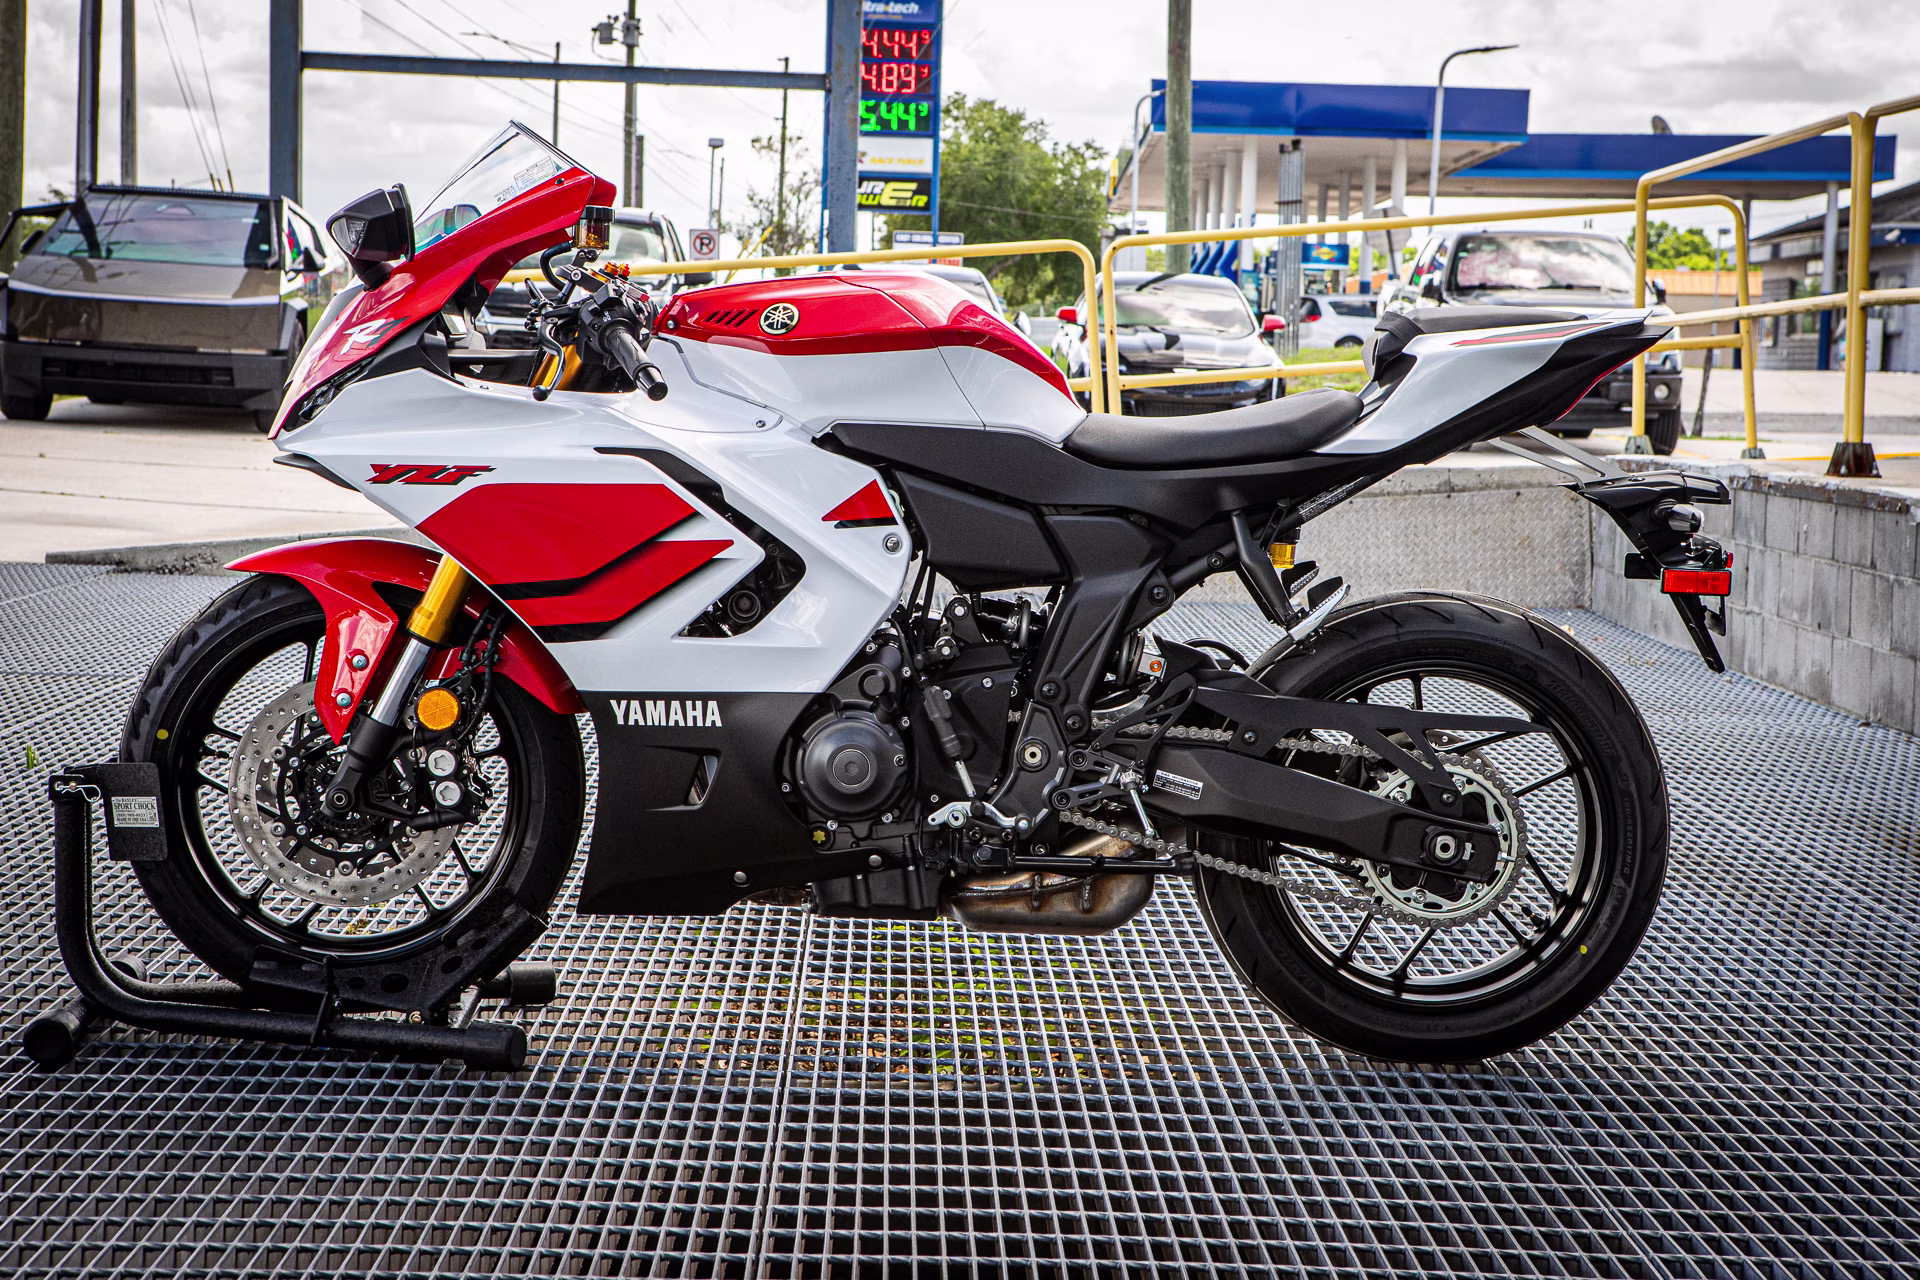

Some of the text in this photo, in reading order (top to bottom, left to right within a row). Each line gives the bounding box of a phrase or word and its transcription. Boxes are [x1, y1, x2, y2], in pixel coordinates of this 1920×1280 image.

[340, 315, 410, 355] R7
[610, 700, 722, 726] YAMAHA
[114, 802, 155, 810] SPORT CHOCK
